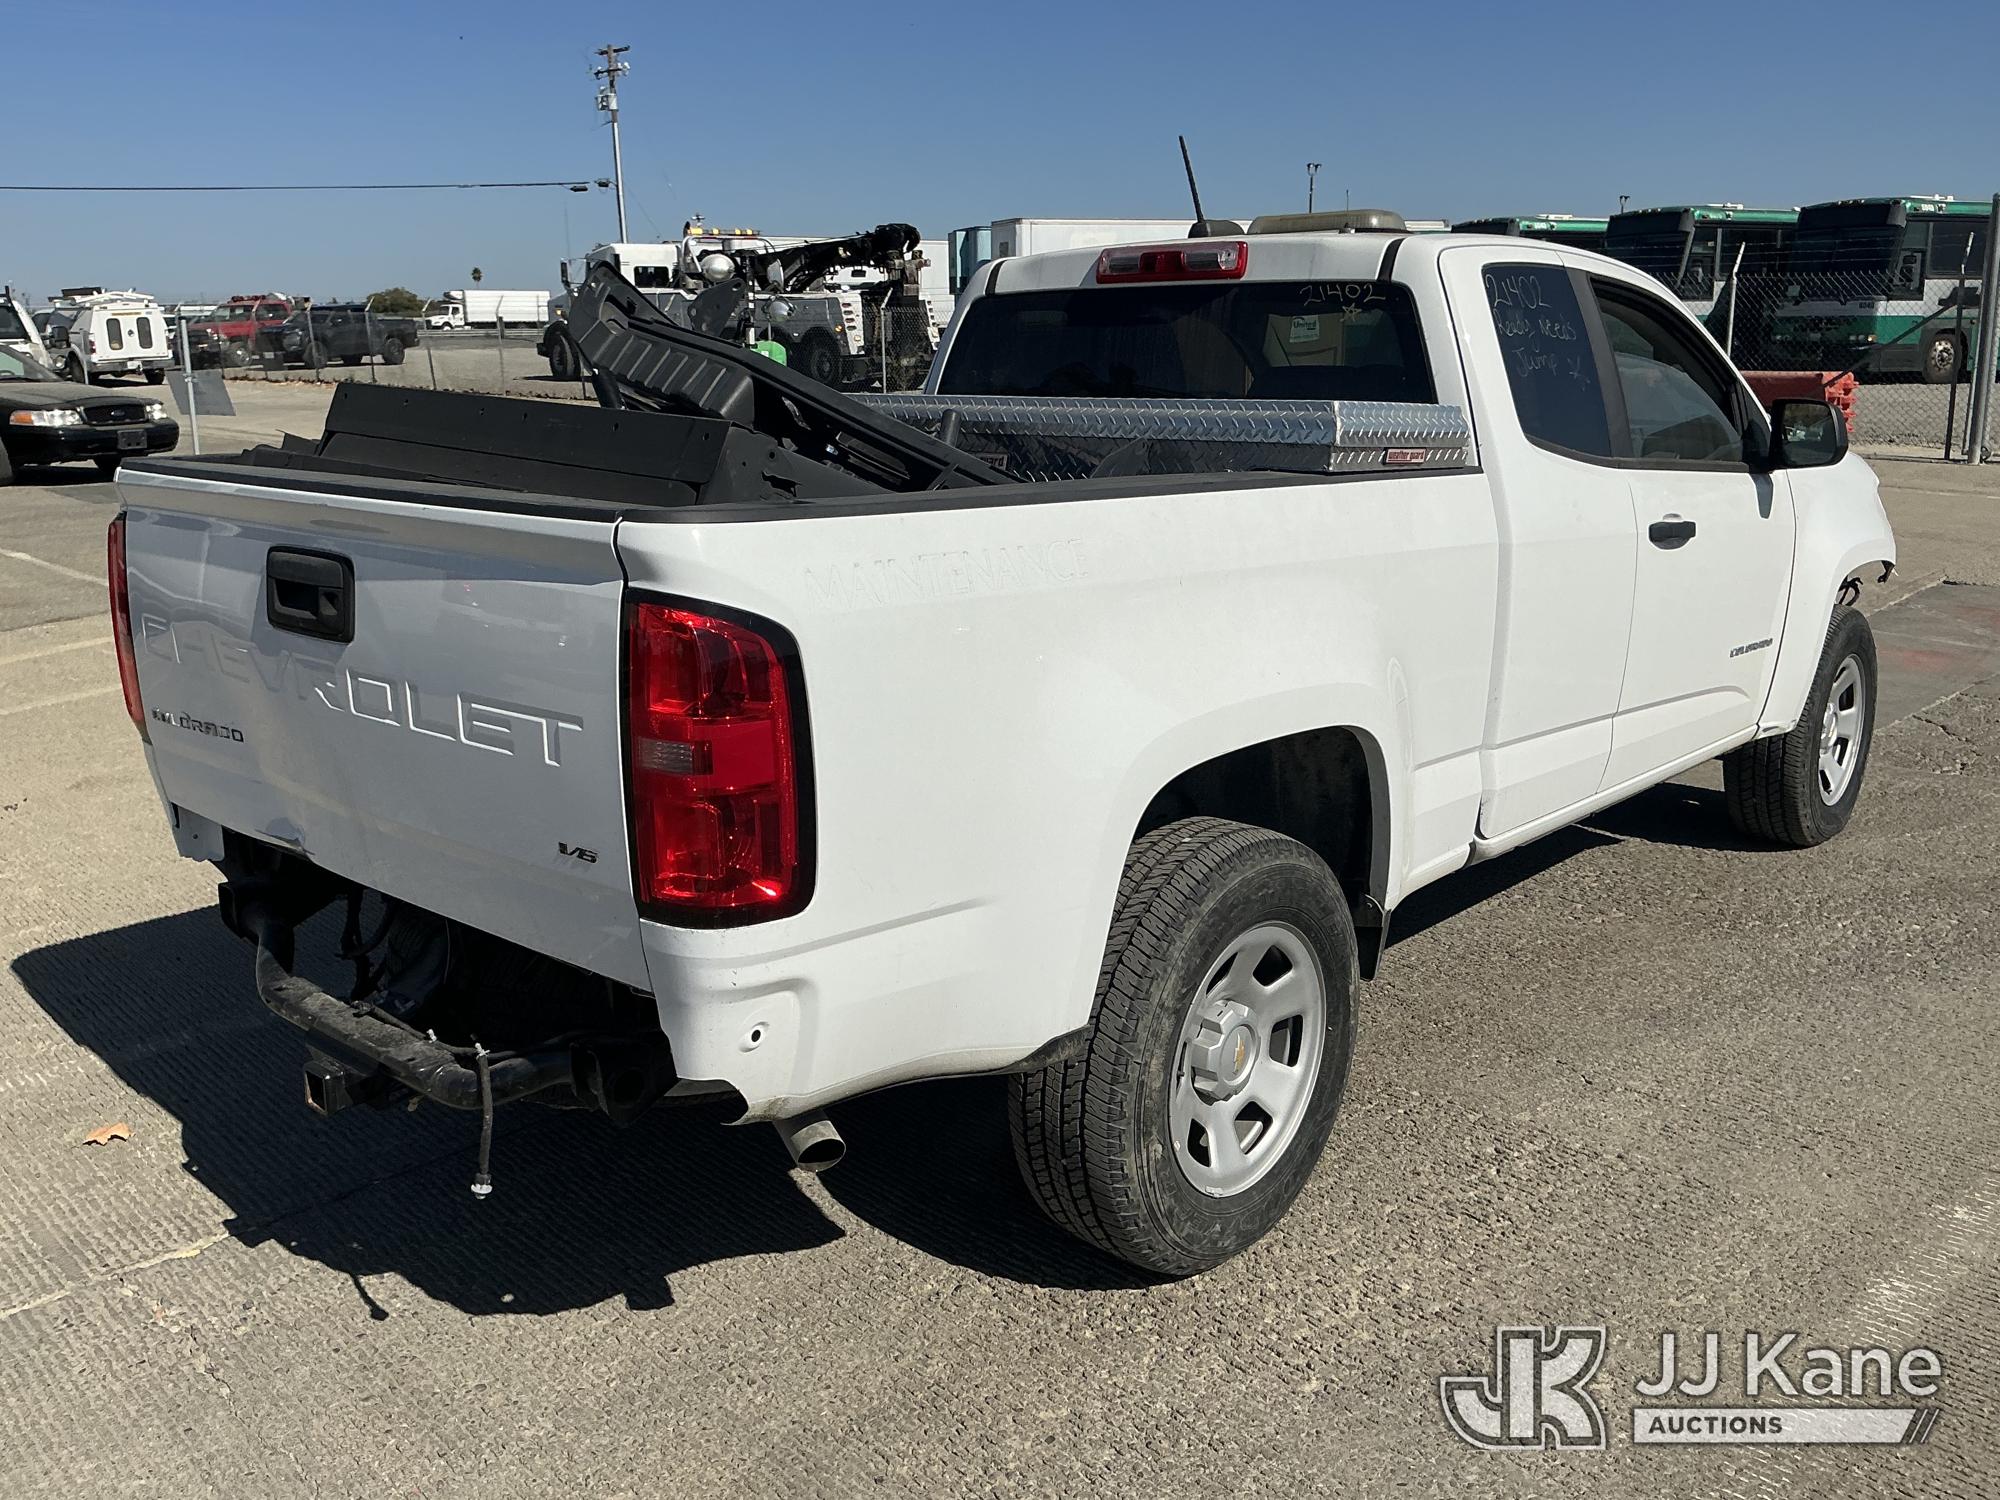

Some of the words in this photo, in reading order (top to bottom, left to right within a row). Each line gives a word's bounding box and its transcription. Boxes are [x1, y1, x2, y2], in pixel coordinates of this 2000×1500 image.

[1300, 283, 1386, 306] 21402
[1485, 274, 1552, 309] 21402
[1511, 346, 1558, 377] Jump
[558, 841, 598, 864] V6
